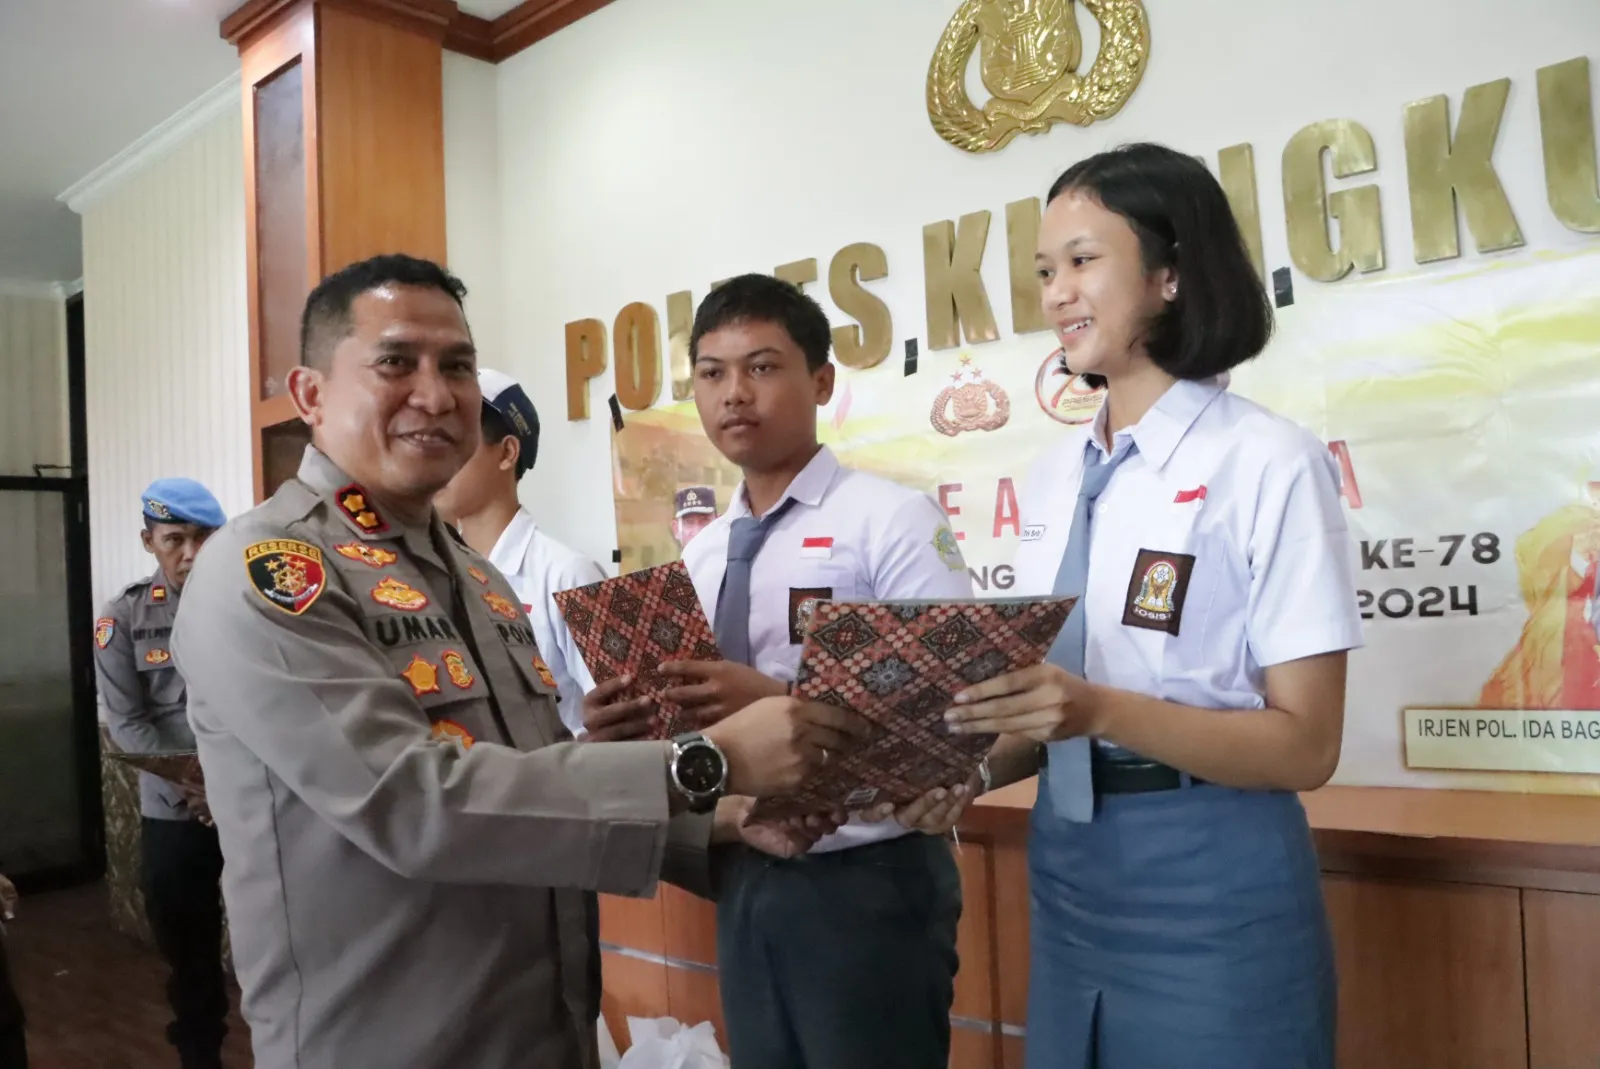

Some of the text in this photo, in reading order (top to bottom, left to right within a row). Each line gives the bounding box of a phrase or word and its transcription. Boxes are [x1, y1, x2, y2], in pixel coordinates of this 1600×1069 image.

[1356, 585, 1478, 619] 2024
[1418, 719, 1470, 737] IRJEN
[1476, 719, 1517, 738] POL.
[1523, 720, 1555, 738] IDA
